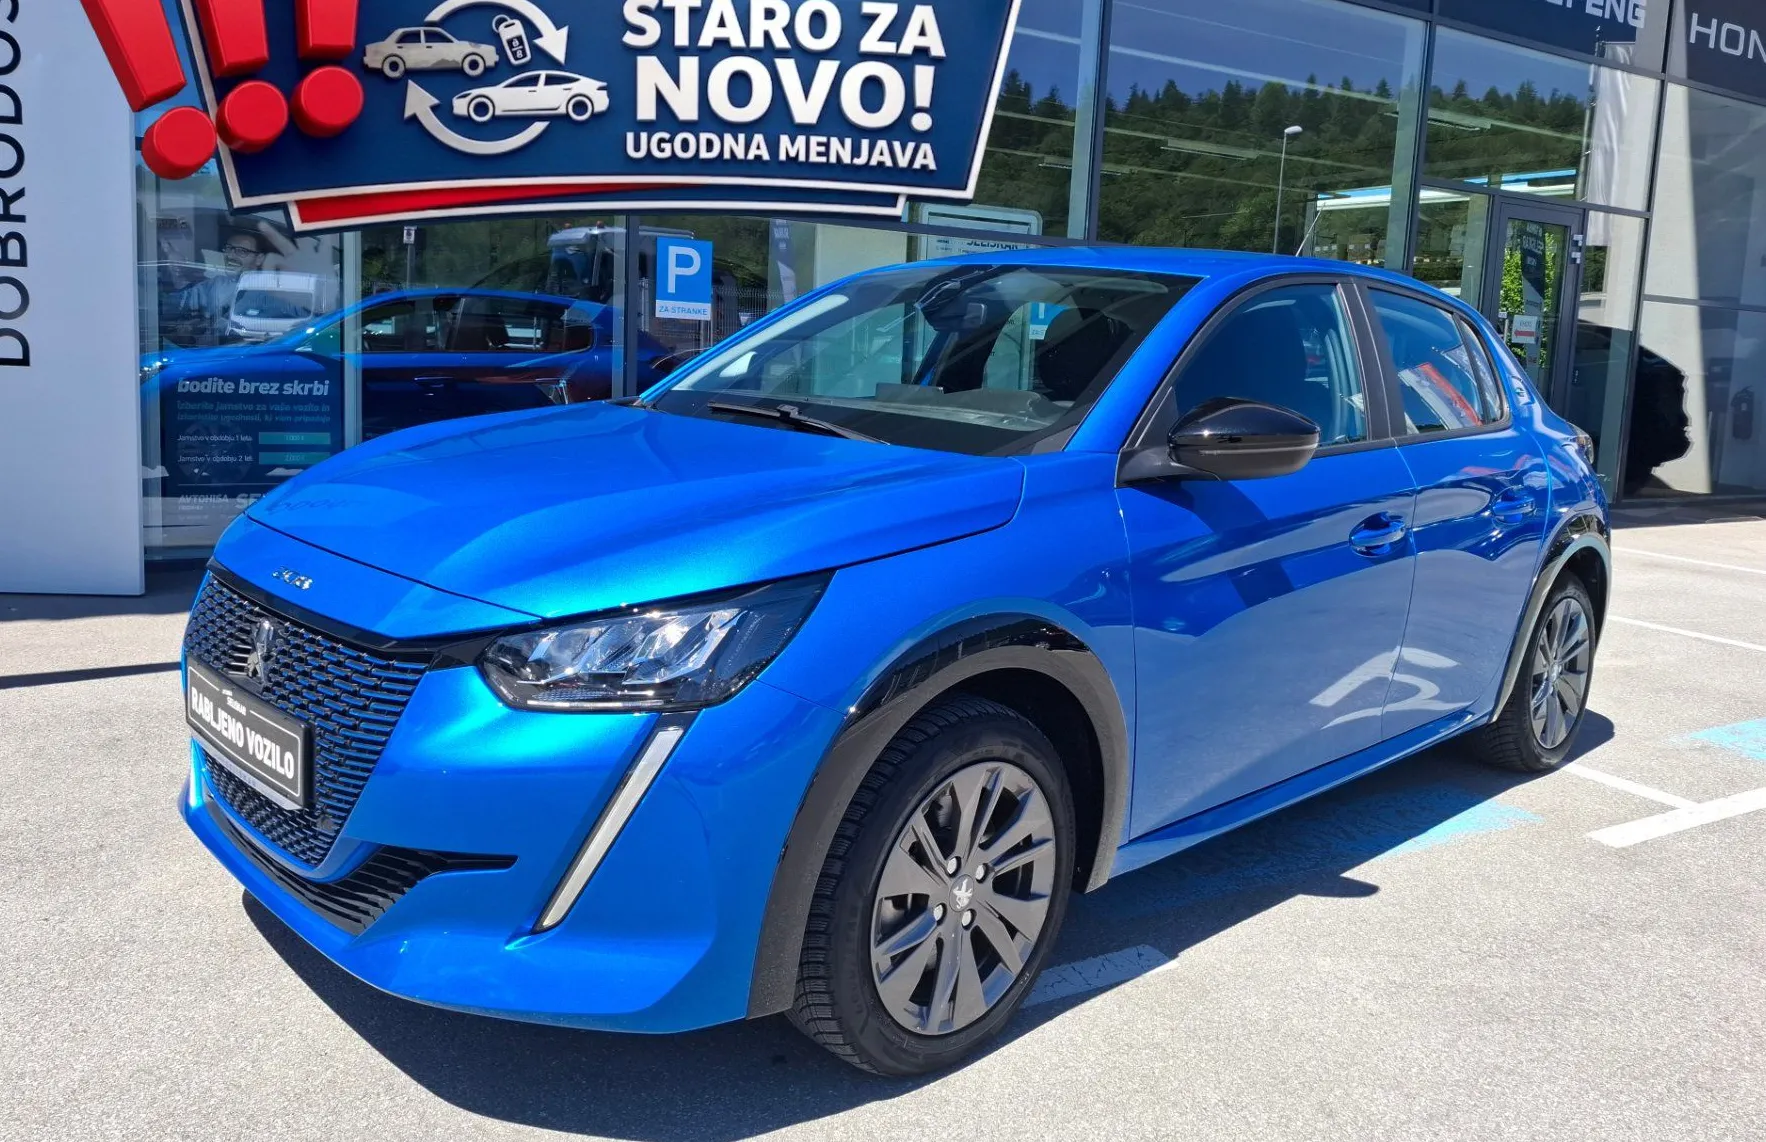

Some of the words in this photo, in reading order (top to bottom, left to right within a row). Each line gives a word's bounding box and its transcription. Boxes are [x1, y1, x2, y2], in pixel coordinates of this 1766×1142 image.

[667, 245, 701, 294] P
[658, 305, 671, 314] ZA
[671, 306, 708, 316] STRANKE
[177, 376, 235, 394] bodite
[238, 378, 280, 395] brez
[282, 379, 330, 396] skrbi
[191, 686, 244, 748] RABLJENO
[245, 726, 295, 780] VOZILO
